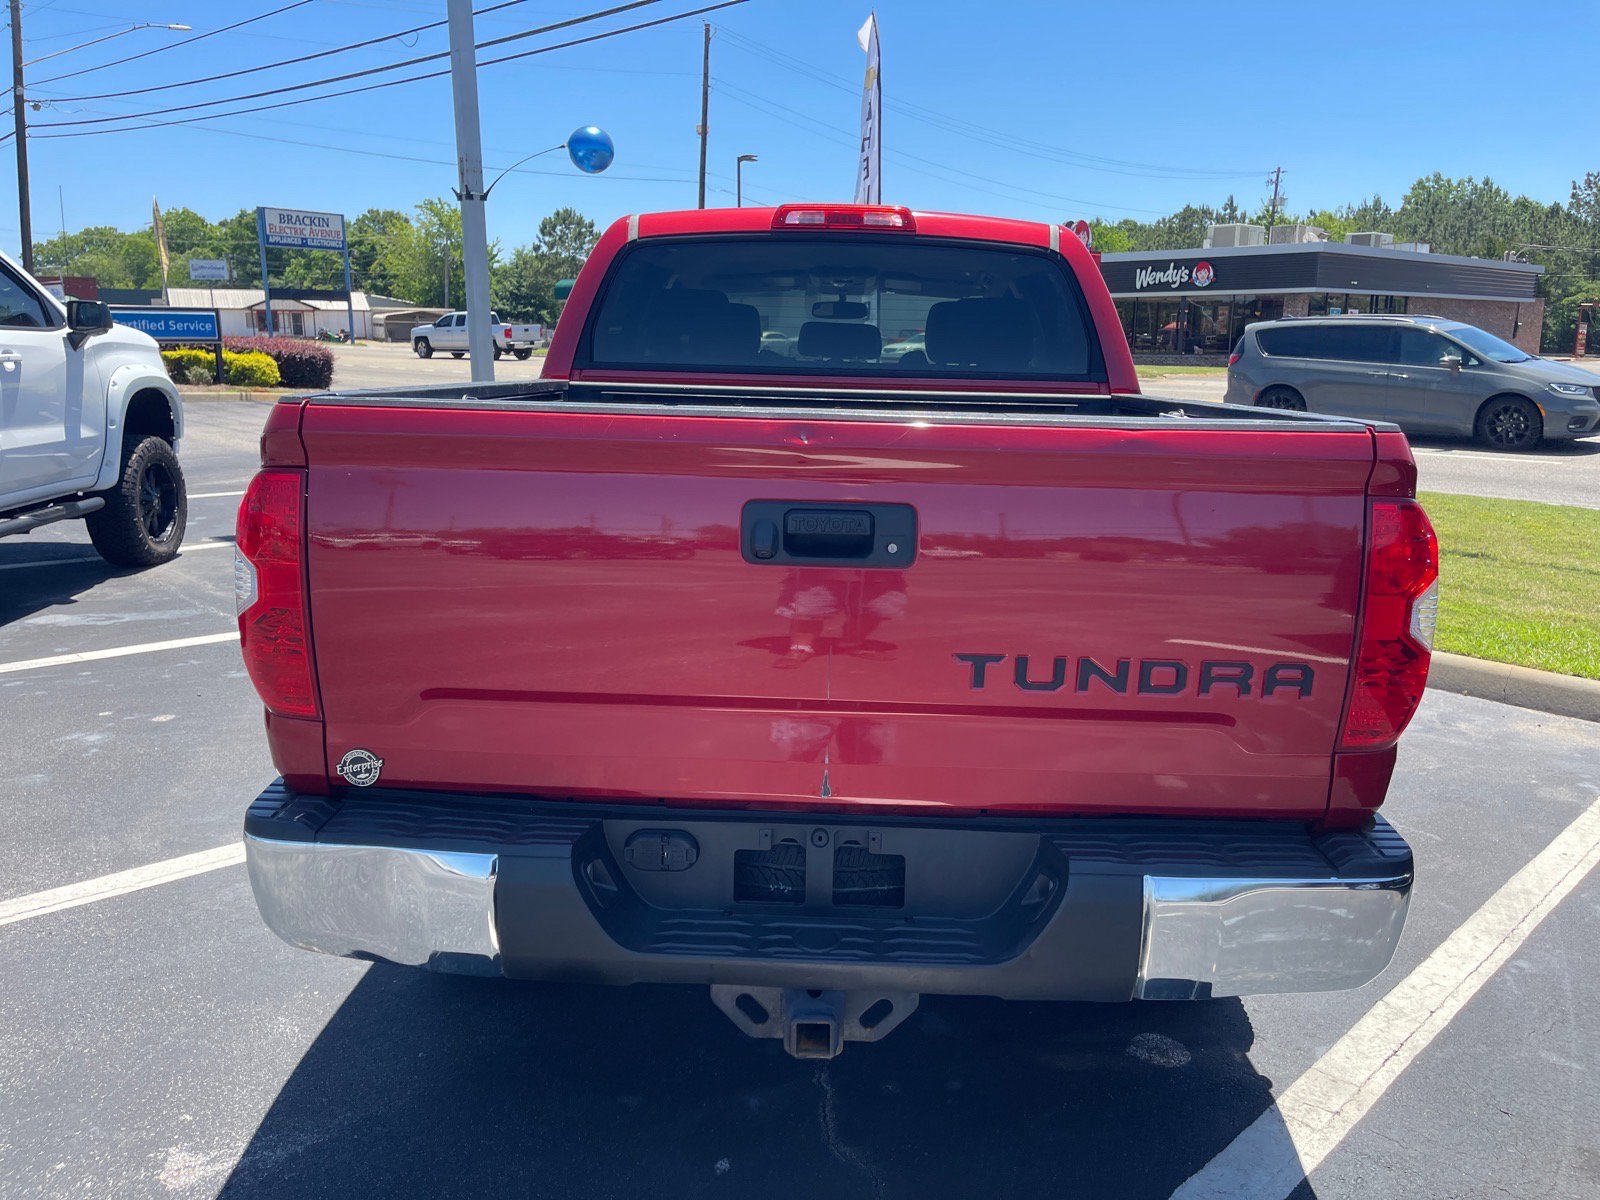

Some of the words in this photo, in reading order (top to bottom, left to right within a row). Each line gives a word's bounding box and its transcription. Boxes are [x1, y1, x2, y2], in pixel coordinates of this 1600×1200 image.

[278, 213, 330, 228] BRACKIN
[268, 223, 307, 237] ELECTRIC
[308, 226, 342, 240] AVENUE
[1135, 262, 1190, 290] Wendy's
[168, 319, 213, 332] Service
[793, 516, 867, 533] TOYOTA
[952, 653, 1315, 699] TUNDRA
[336, 759, 384, 775] Enterprise
